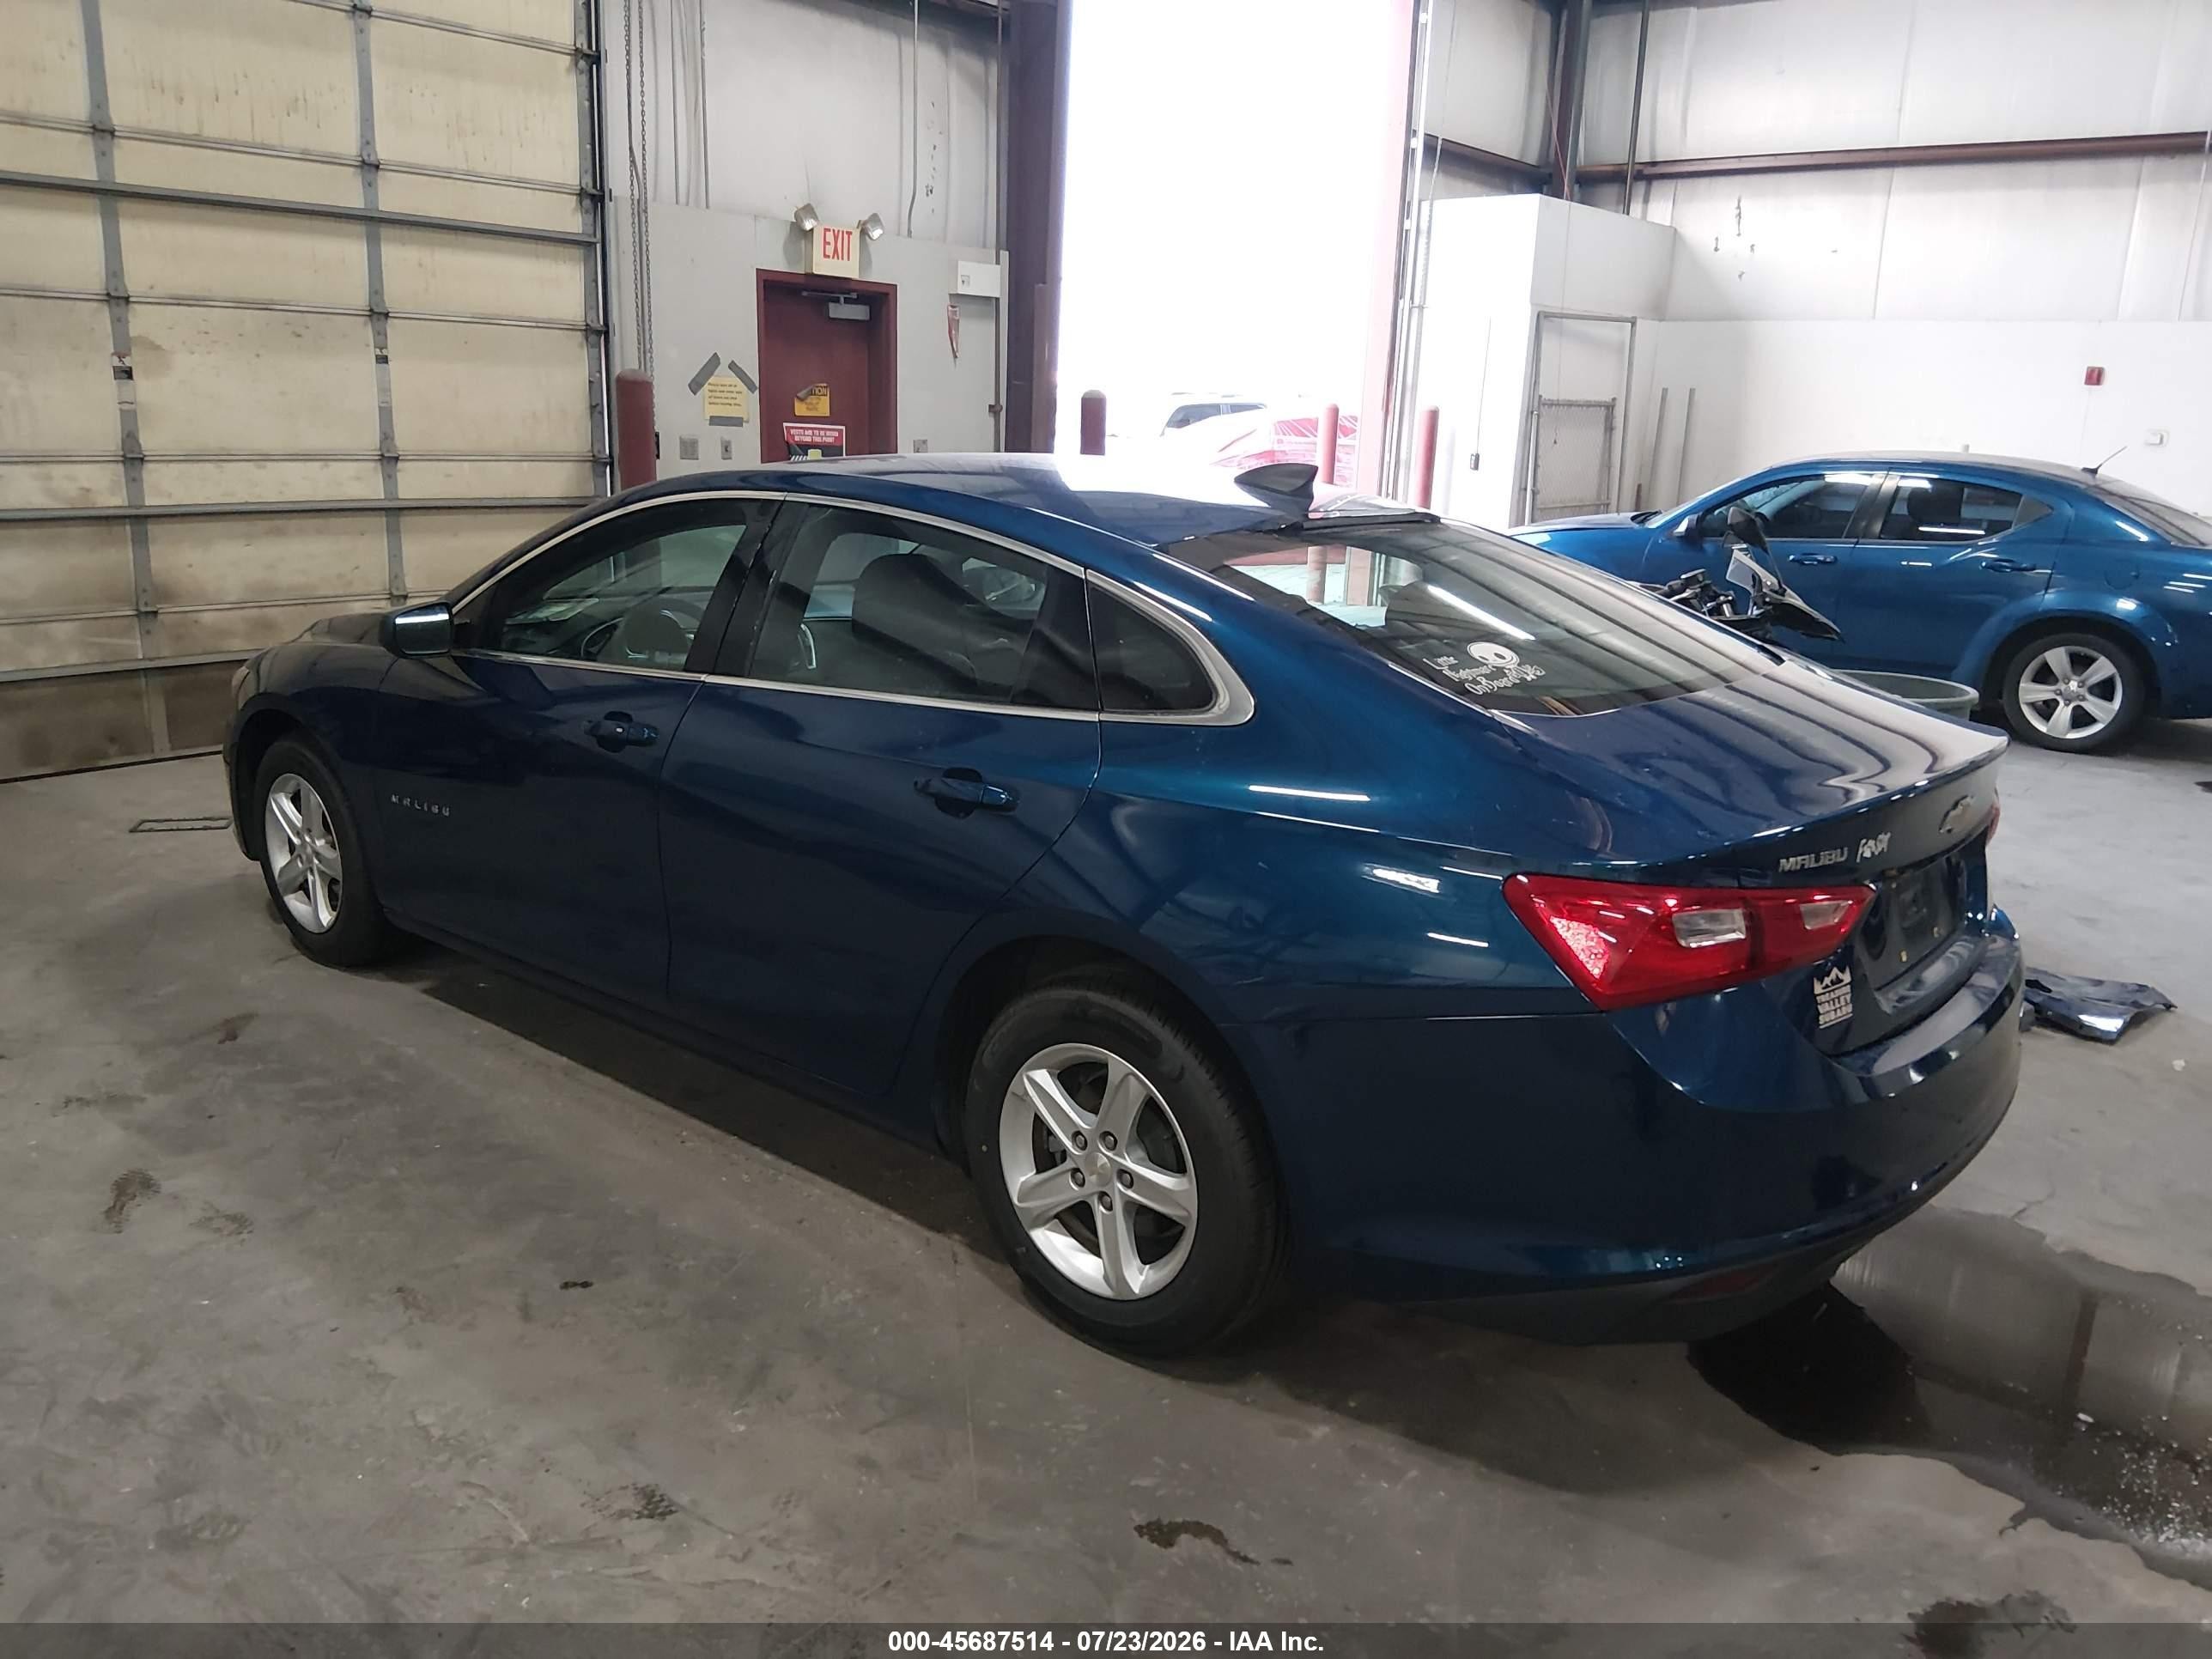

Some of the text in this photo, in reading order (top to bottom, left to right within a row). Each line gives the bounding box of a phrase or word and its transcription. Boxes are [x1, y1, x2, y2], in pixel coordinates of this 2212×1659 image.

[823, 228, 853, 261] EXIT
[391, 794, 450, 817] MALIBU
[1778, 847, 1848, 872] MALIBU
